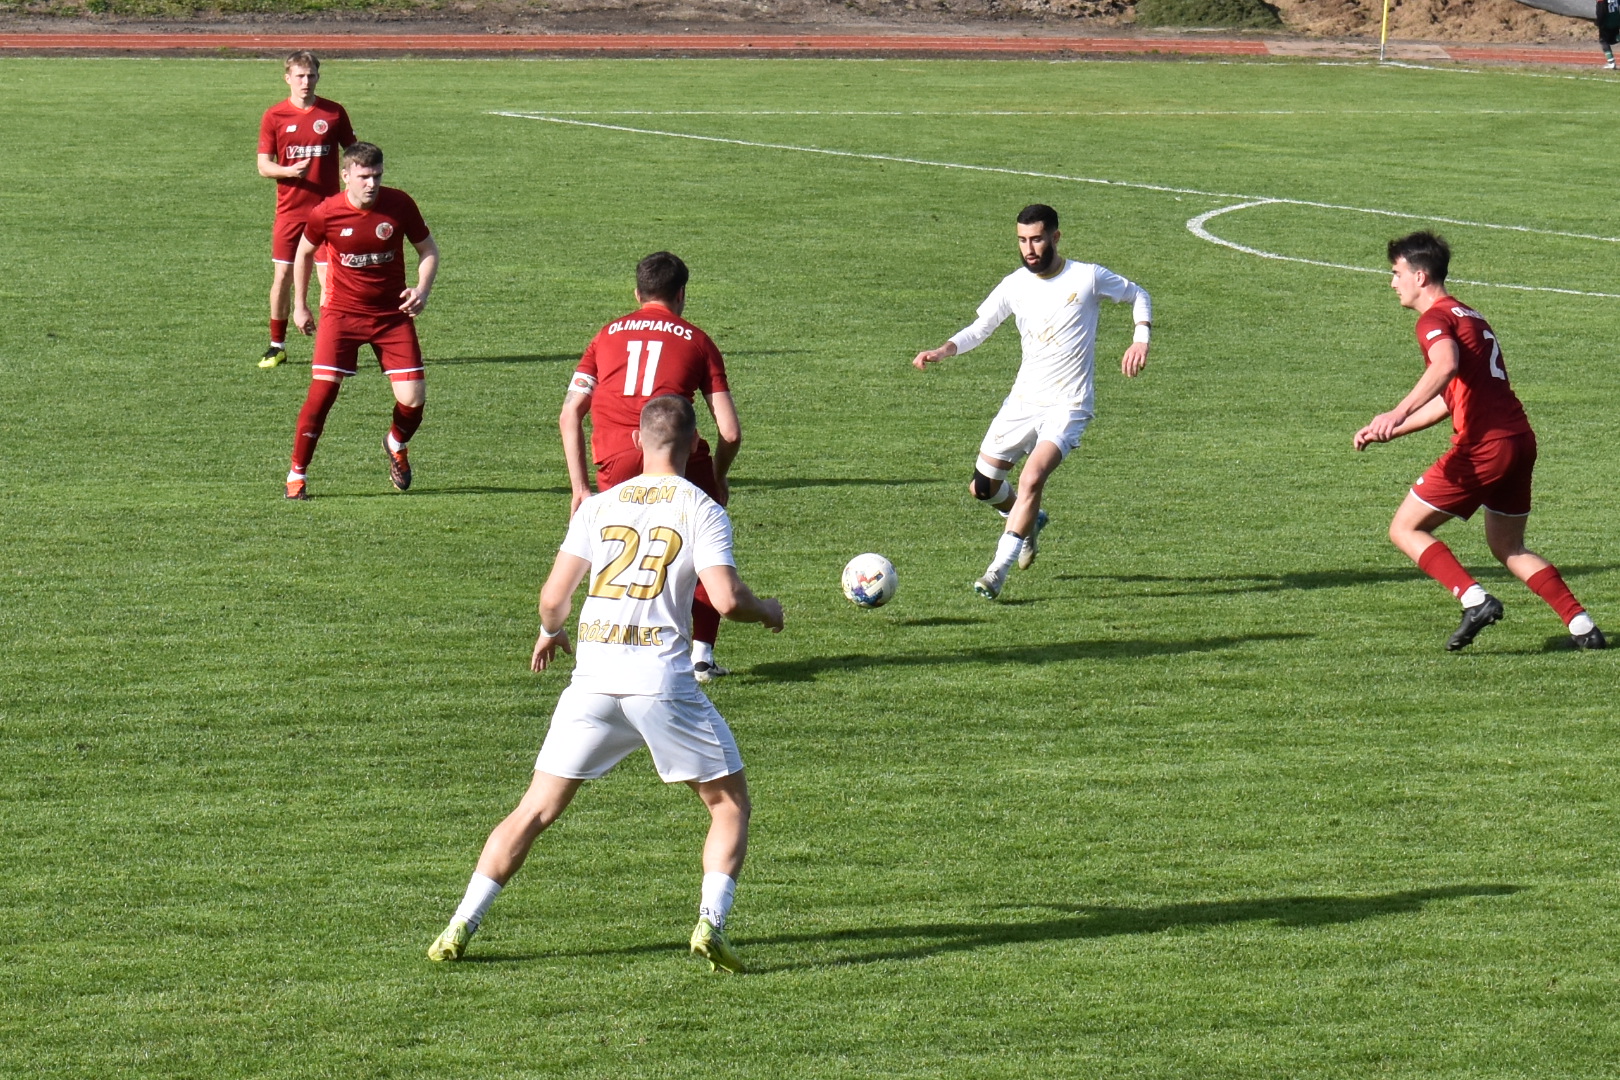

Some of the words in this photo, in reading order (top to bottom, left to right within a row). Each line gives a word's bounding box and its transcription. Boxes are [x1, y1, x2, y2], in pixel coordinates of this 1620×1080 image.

[608, 319, 693, 340] OLIMPIAKOS
[624, 340, 663, 396] 11
[588, 524, 683, 600] 23
